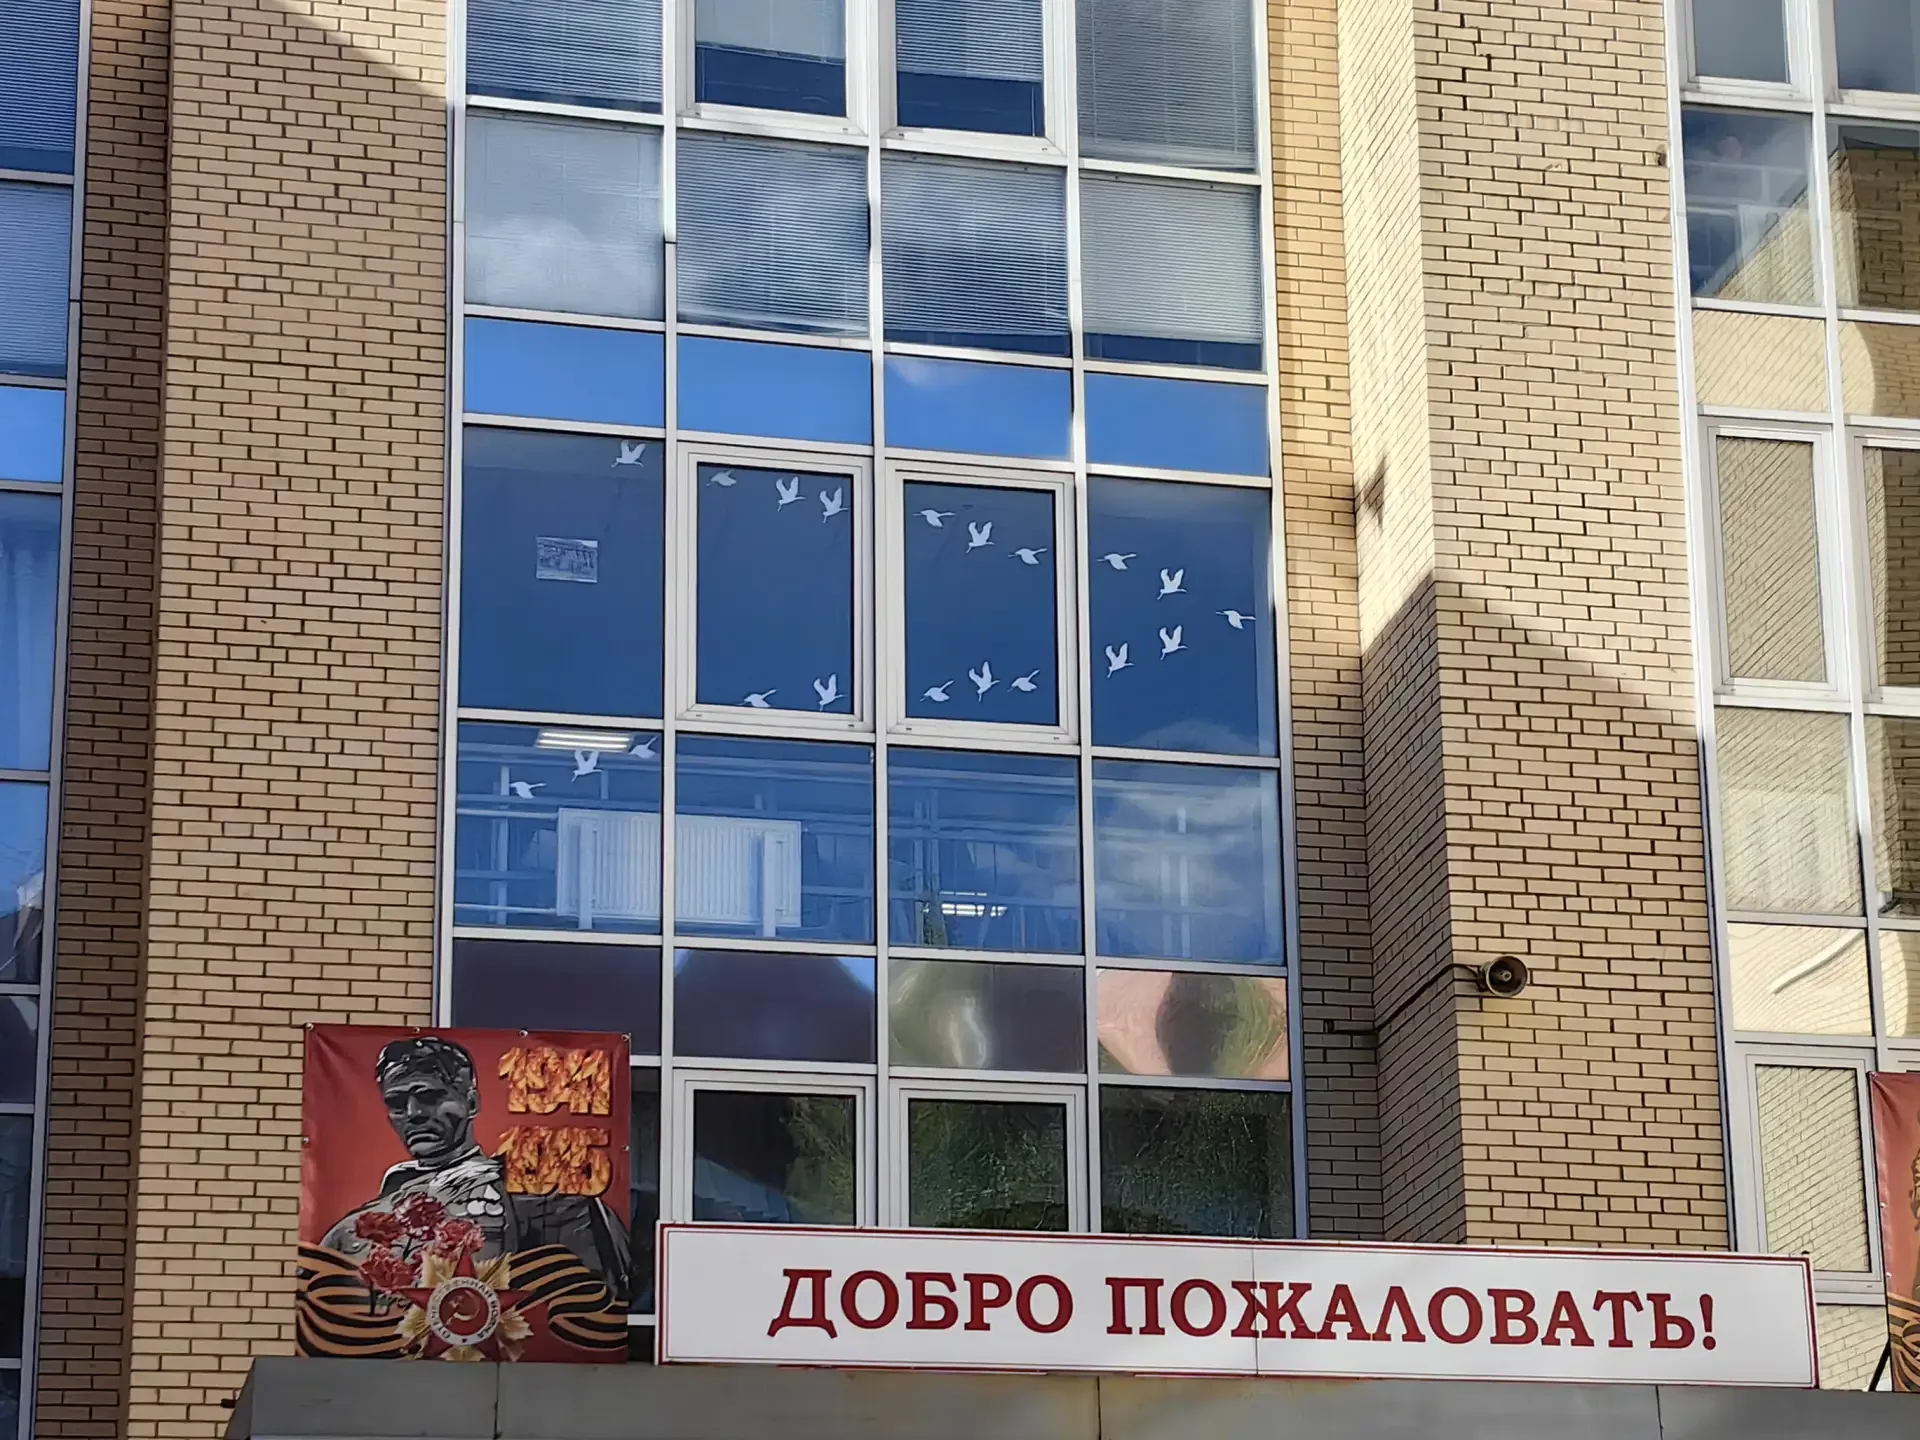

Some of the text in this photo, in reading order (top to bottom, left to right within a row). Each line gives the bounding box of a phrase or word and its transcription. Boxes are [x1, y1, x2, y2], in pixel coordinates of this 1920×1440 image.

[498, 1046, 611, 1115] 1941
[495, 1125, 613, 1197] 1945
[767, 1268, 1717, 1350] ДОБРО ПОЖАЛОВАТЬ!
